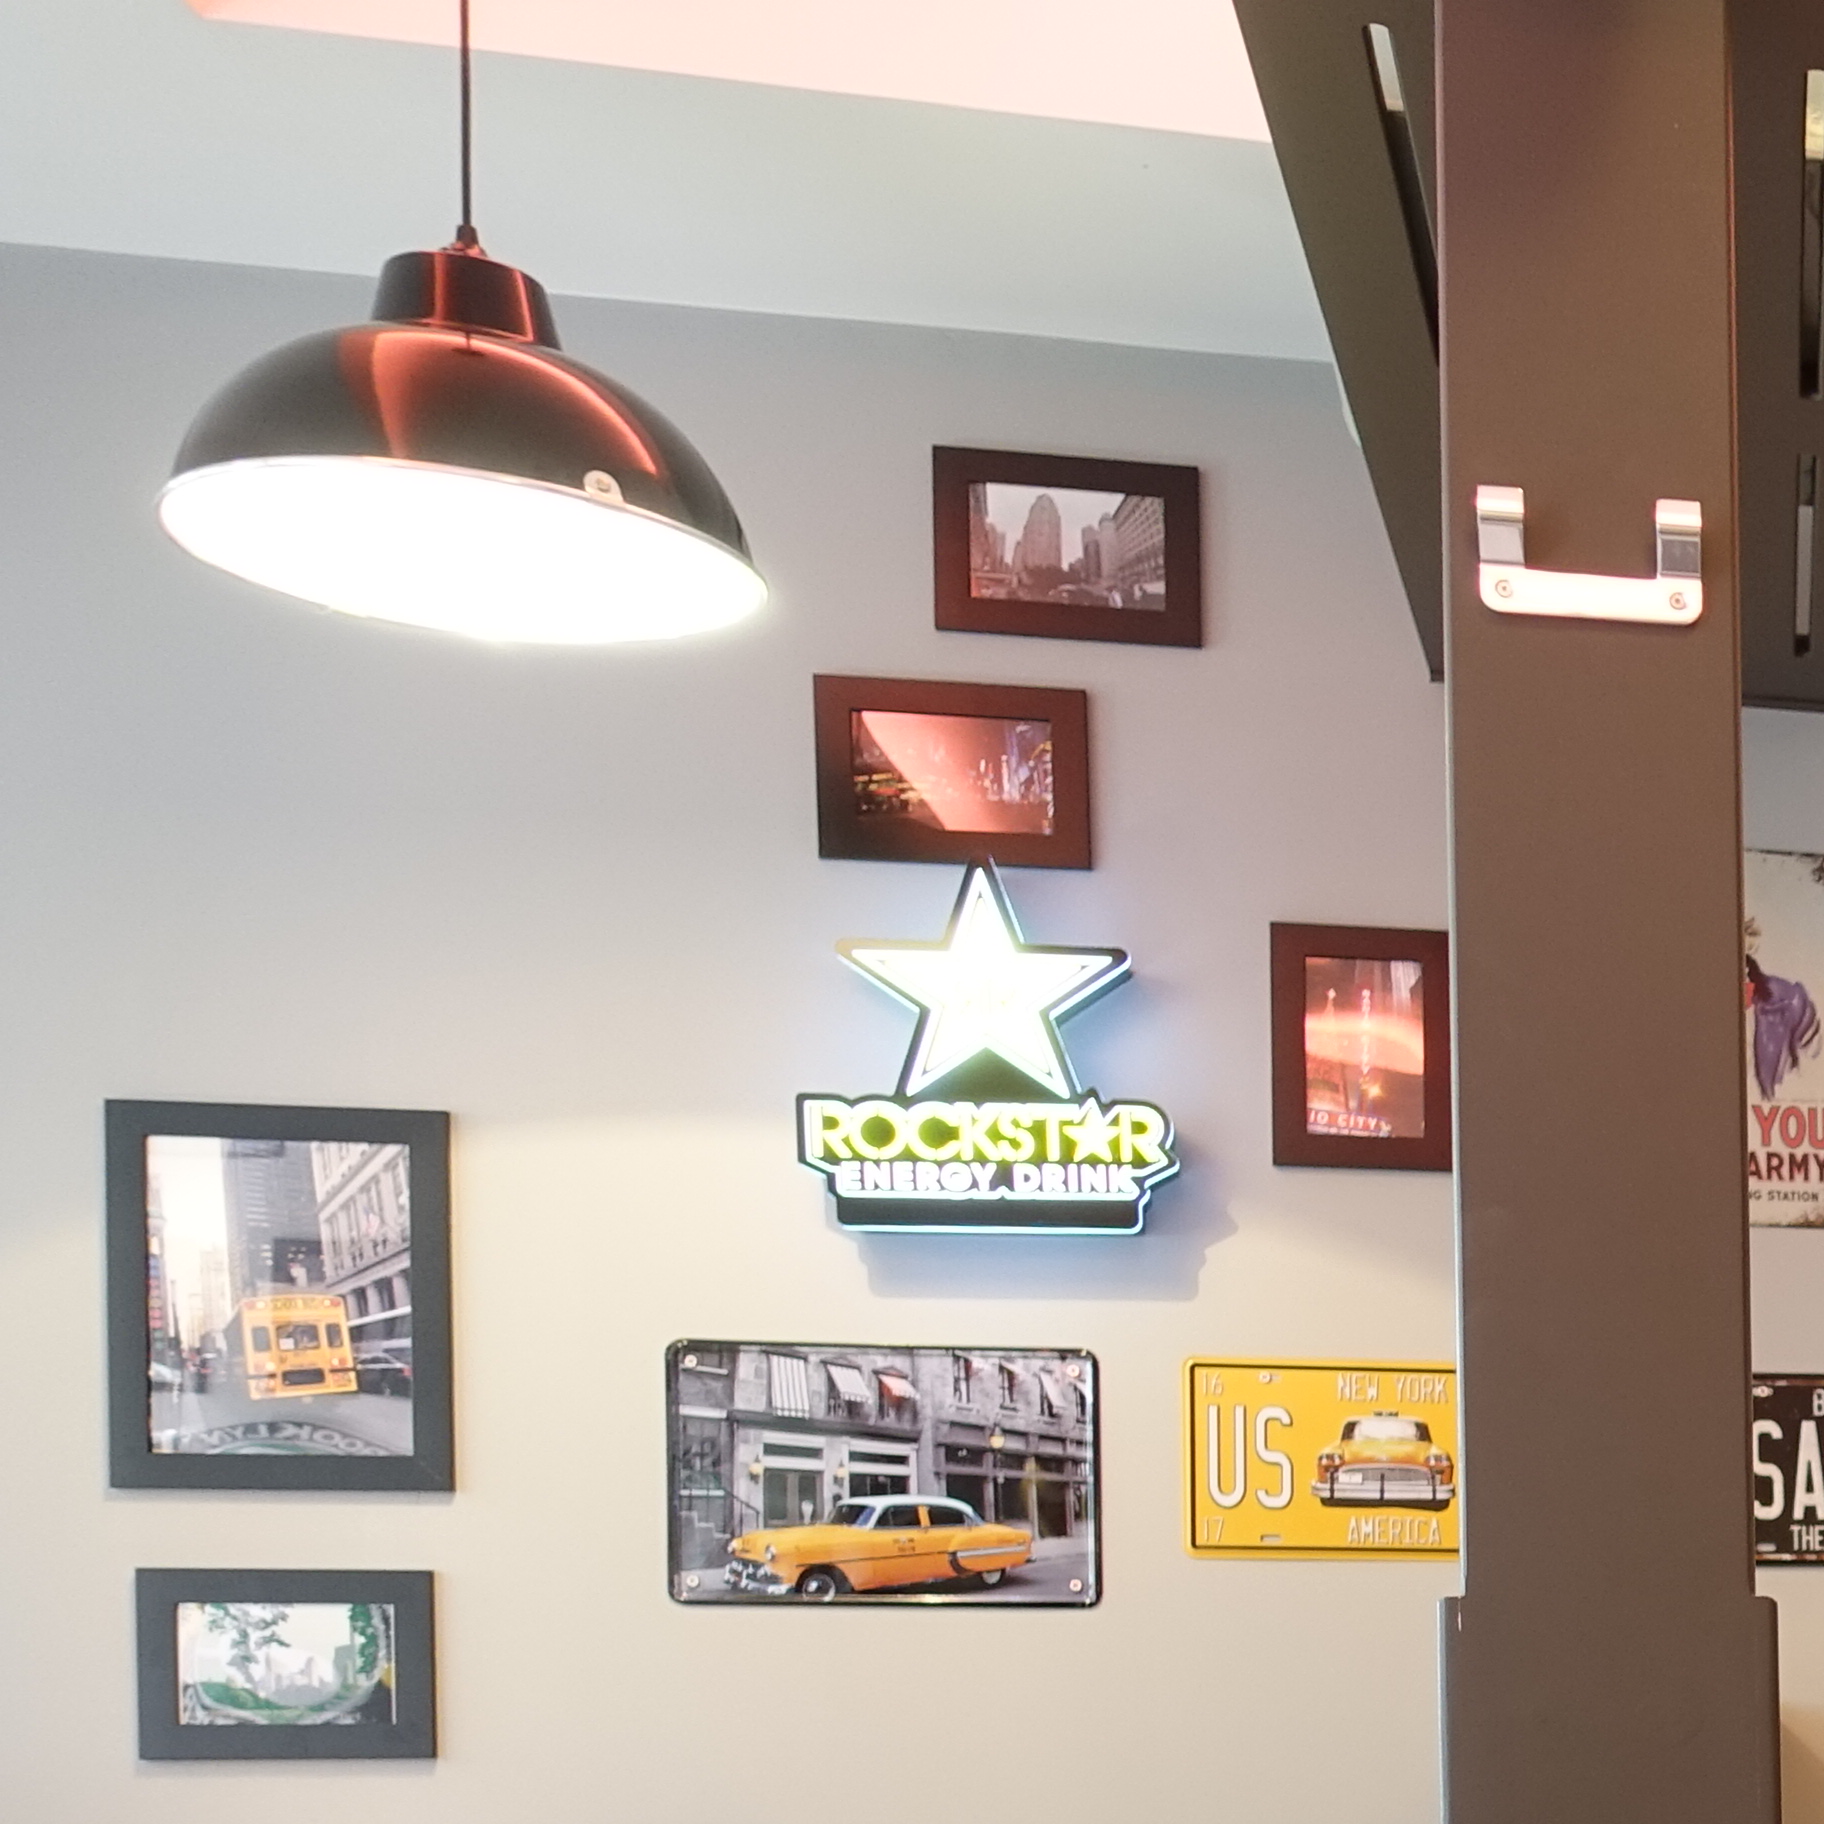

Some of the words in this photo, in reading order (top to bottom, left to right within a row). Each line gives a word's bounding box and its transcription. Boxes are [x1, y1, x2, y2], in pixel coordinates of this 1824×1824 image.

[1338, 1113, 1377, 1130] CITY
[840, 1161, 998, 1192] ENERGY
[1013, 1164, 1138, 1193] DRINK
[1767, 1190, 1819, 1201] STATION
[1201, 1372, 1223, 1397] 16
[1338, 1372, 1379, 1401] NEW
[1393, 1375, 1449, 1404] YORK
[1207, 1404, 1293, 1509] US
[1203, 1515, 1224, 1543] 17
[1349, 1515, 1441, 1545] AMERICA
